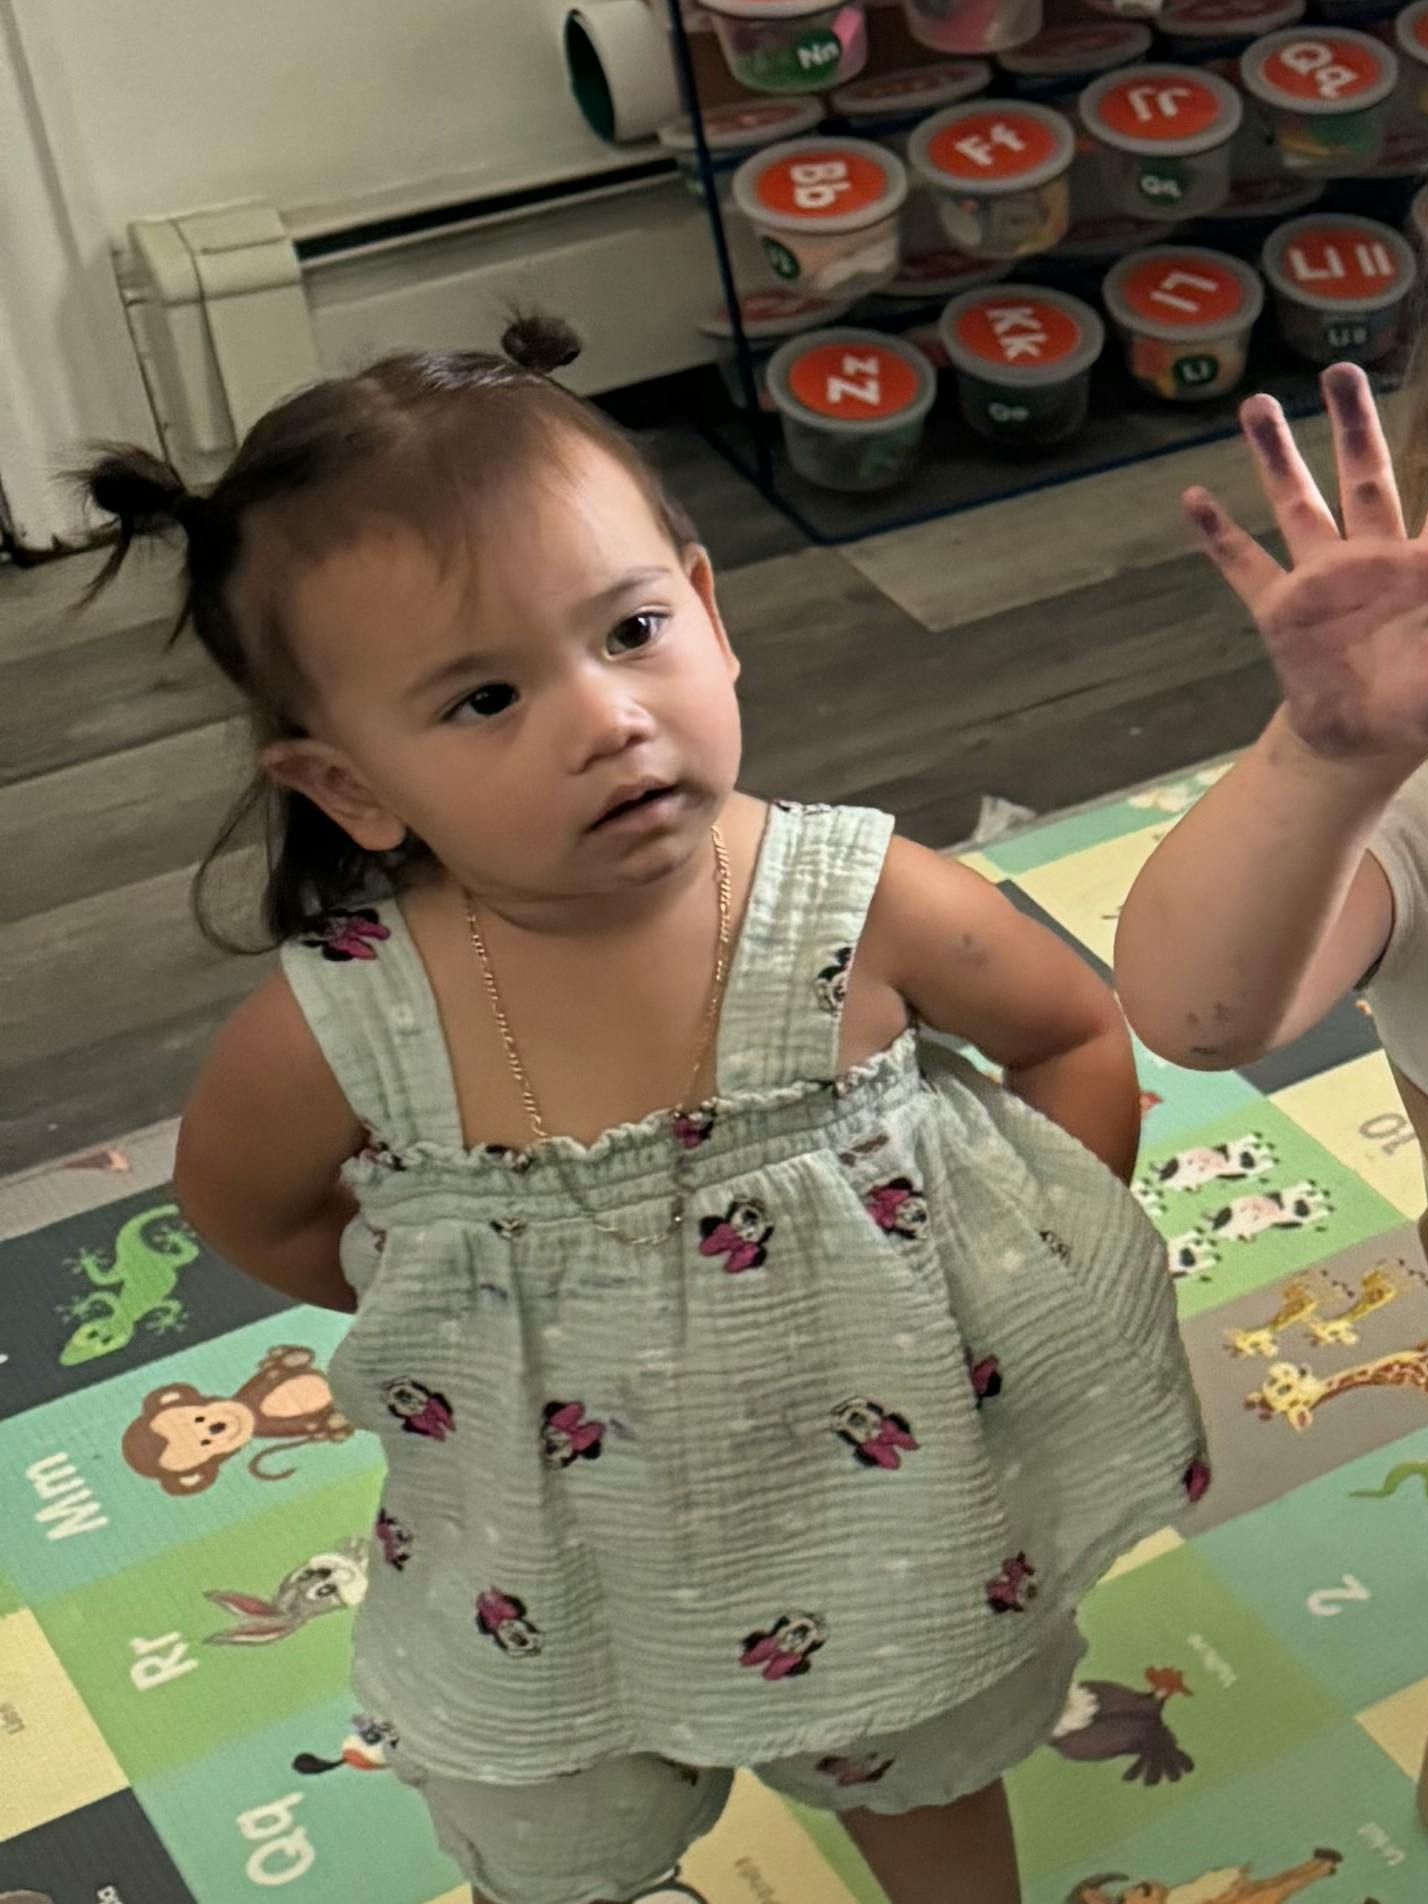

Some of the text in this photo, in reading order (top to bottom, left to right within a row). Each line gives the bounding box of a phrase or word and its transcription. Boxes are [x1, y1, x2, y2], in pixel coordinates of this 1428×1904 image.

[798, 41, 840, 70] Nn
[1280, 41, 1357, 98] Qq
[954, 123, 1026, 167] Ff
[790, 160, 851, 209] Bb
[985, 306, 1050, 360] Kk
[827, 354, 880, 406] Zz
[25, 1451, 109, 1544] Mm
[1306, 1573, 1371, 1617] 2
[129, 1630, 200, 1692] Rr
[235, 1791, 316, 1886] Qq
